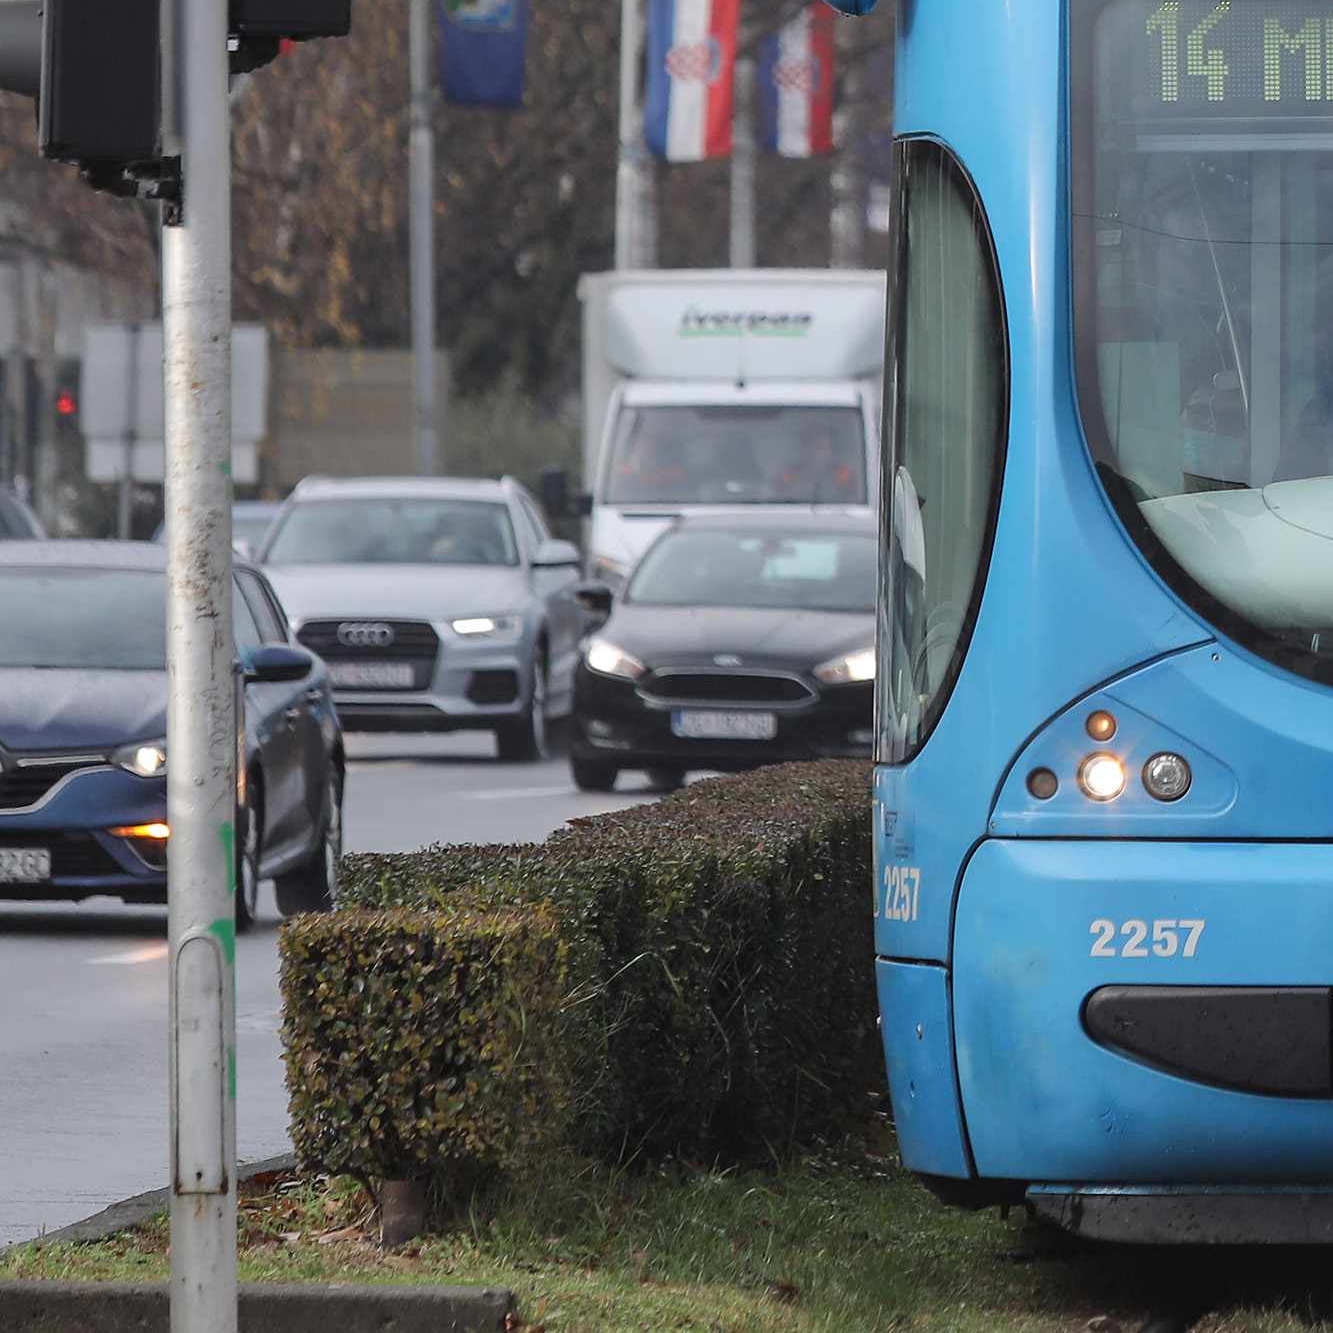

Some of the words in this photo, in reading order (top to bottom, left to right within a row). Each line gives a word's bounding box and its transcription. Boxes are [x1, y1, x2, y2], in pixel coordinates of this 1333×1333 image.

[1146, 1, 1231, 102] 14
[884, 865, 921, 923] 2257
[1089, 919, 1206, 958] 2257
